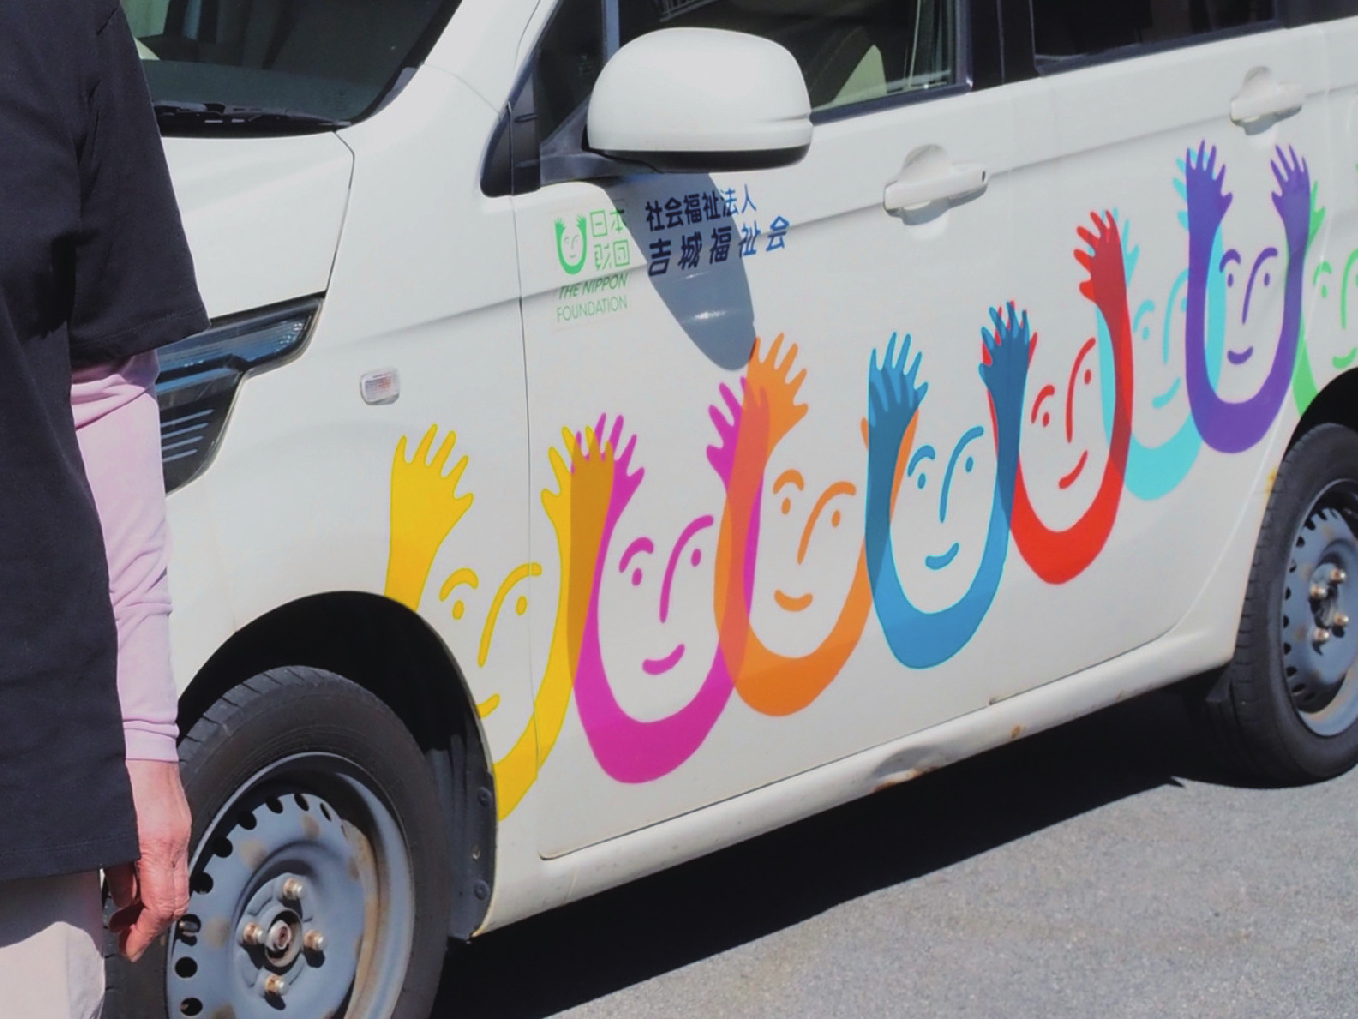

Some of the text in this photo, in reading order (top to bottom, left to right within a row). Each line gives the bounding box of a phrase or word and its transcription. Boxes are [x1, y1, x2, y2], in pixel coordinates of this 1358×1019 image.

[645, 183, 757, 232] 社会福祉法人
[647, 215, 790, 277] 吉城福祉会
[559, 272, 630, 300] THE NIPPON
[556, 296, 628, 322] FOUNDATION
